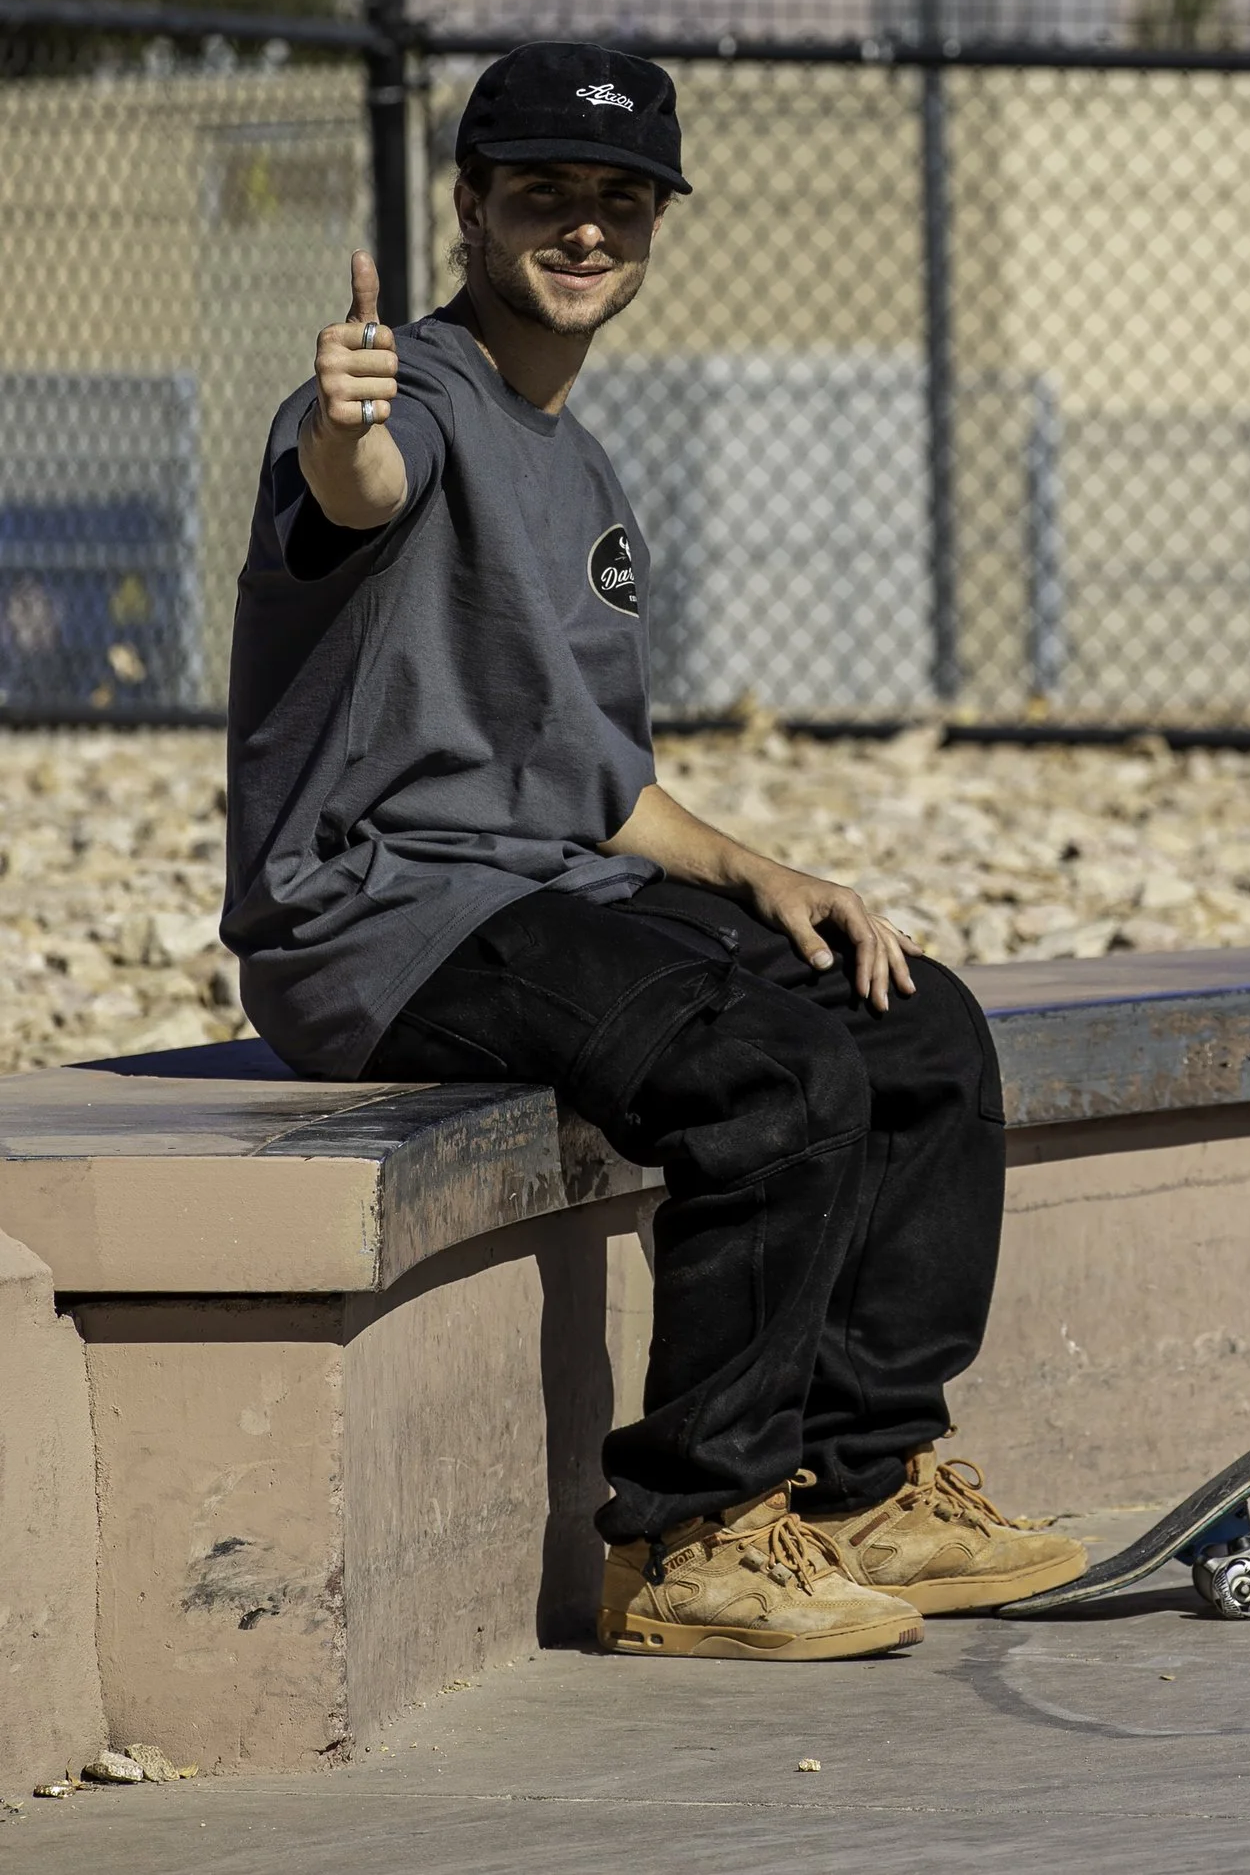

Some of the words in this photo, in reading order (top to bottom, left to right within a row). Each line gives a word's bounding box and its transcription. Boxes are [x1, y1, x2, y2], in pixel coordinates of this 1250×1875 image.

[576, 83, 634, 112] Axion
[600, 566, 635, 591] Dar
[664, 1548, 694, 1575] XION
